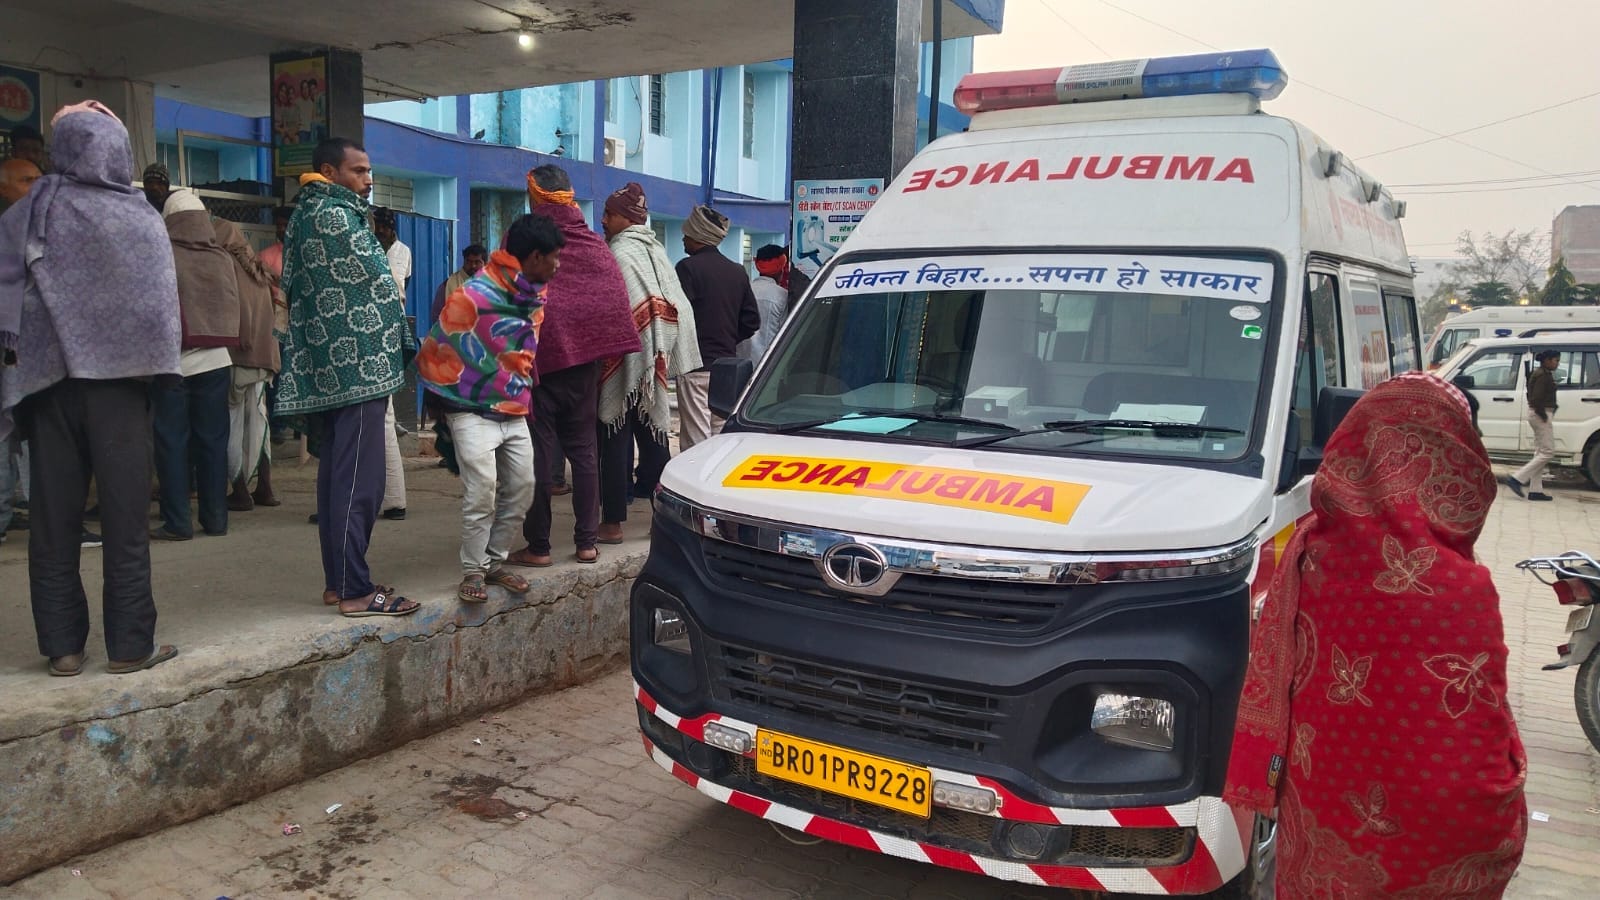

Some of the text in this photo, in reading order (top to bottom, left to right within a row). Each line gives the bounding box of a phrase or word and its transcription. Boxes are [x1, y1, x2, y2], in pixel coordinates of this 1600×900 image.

[842, 201, 856, 211] SCAN
[835, 268, 909, 289] जीवन्त
[1116, 262, 1150, 289] हो
[1160, 270, 1262, 294] साकार
[760, 748, 772, 757] IND
[772, 741, 927, 805] BR01PR9228
